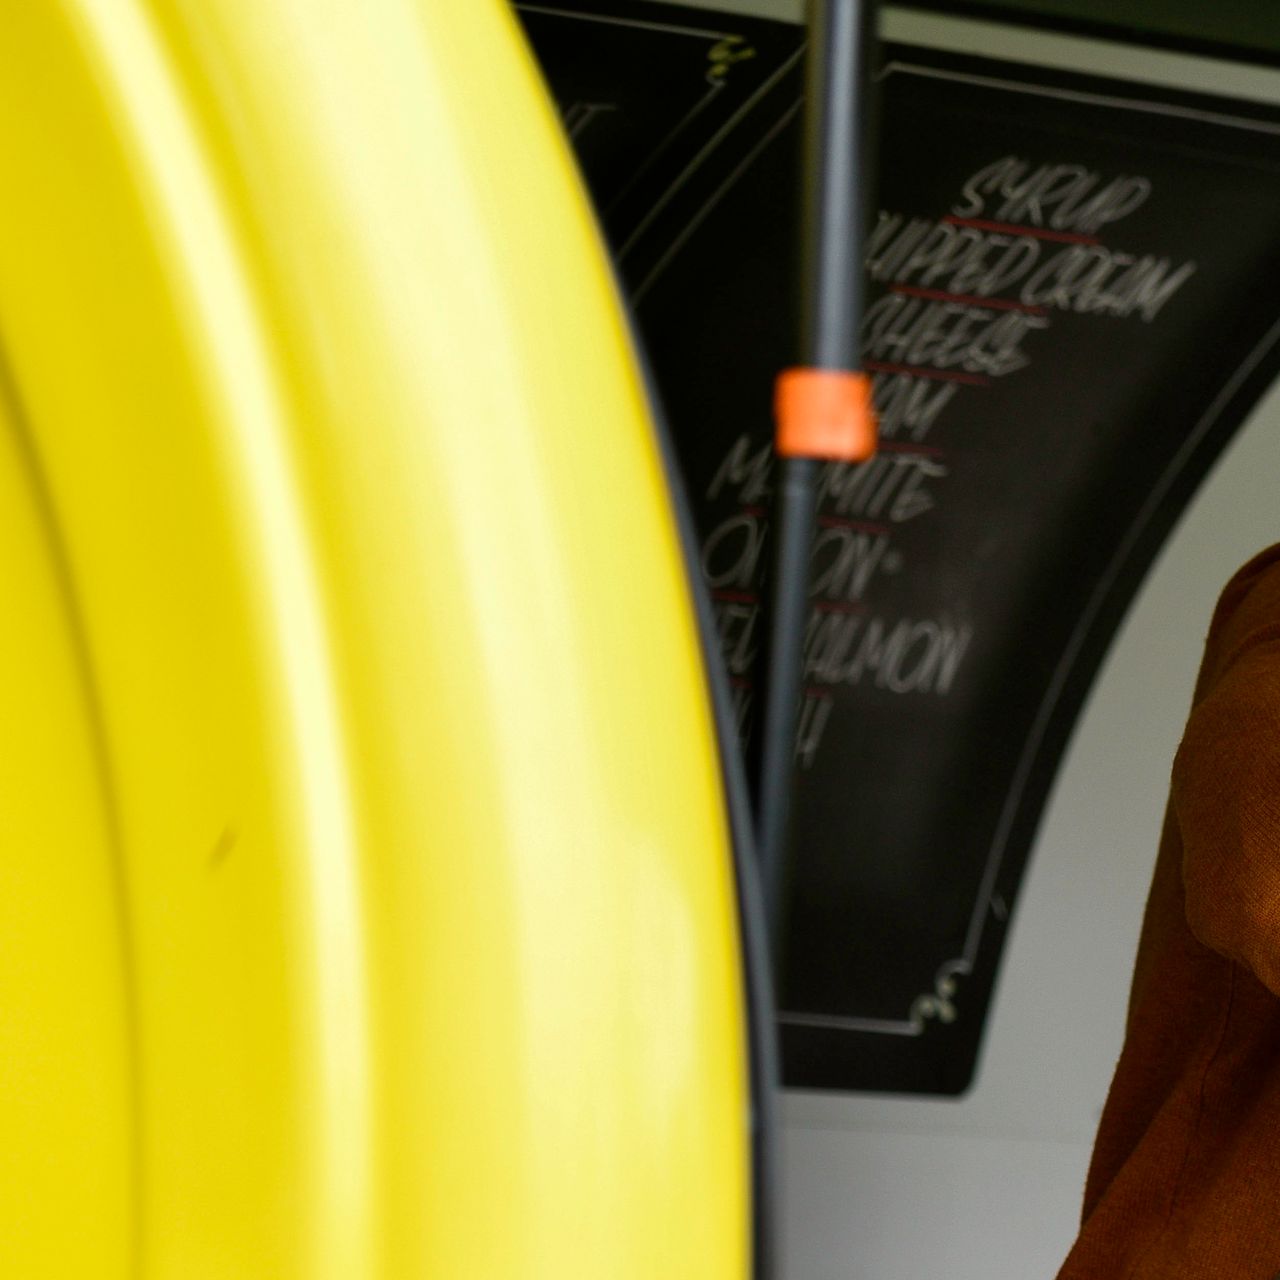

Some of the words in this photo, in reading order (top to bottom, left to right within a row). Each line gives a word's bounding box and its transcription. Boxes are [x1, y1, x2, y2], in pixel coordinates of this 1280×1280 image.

[951, 154, 1153, 234] SYRUP
[1020, 245, 1198, 322] CREAM
[802, 608, 974, 697] ALMON
